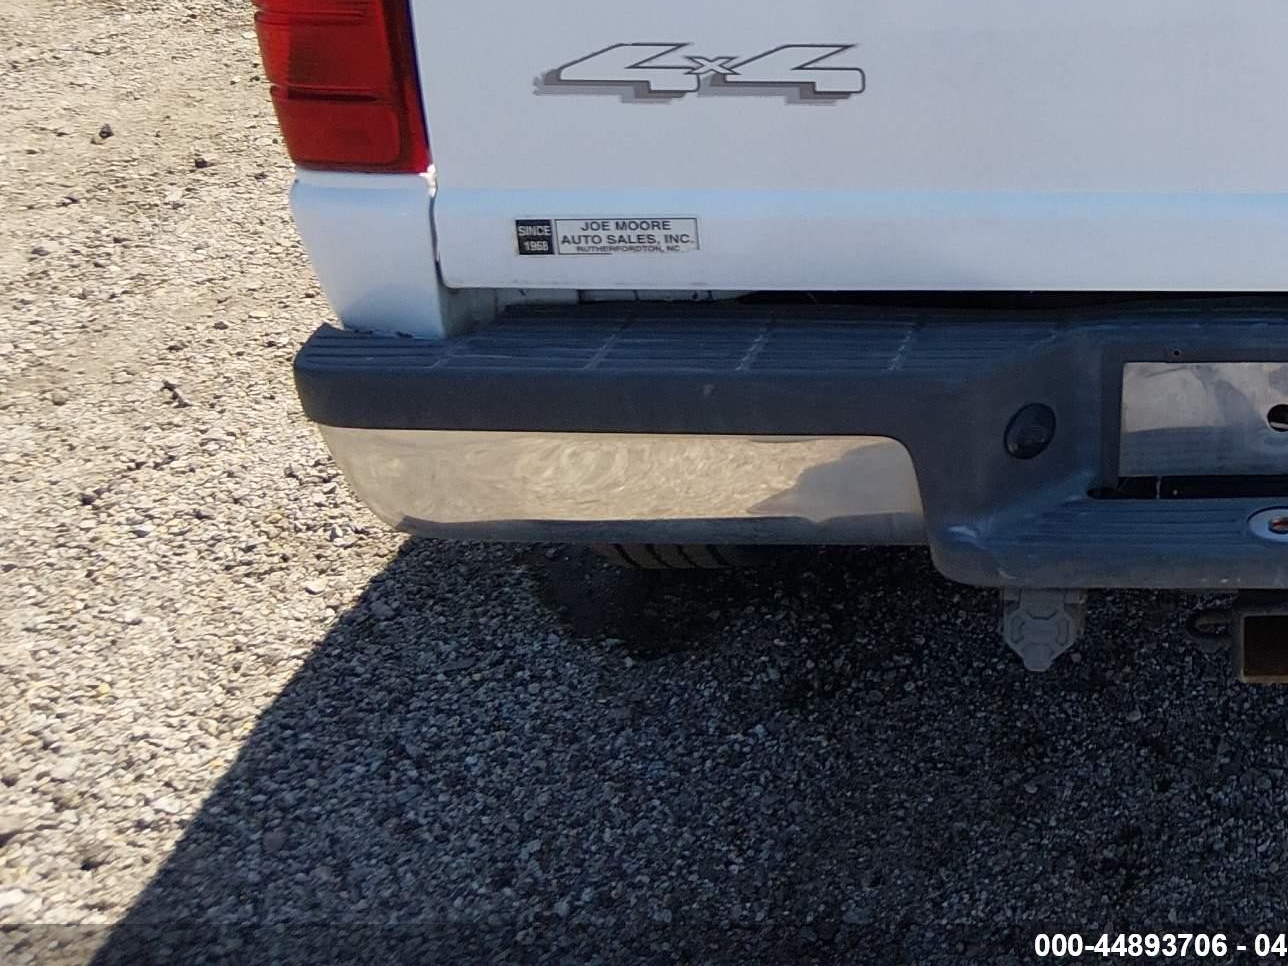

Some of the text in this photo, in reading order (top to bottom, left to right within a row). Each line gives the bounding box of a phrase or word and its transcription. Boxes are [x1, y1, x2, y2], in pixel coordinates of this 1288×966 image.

[533, 43, 866, 106] 4x4
[518, 225, 551, 237] SINCE
[581, 220, 671, 232] JOE MOORE
[561, 233, 695, 245] AUTO SALES, INC.
